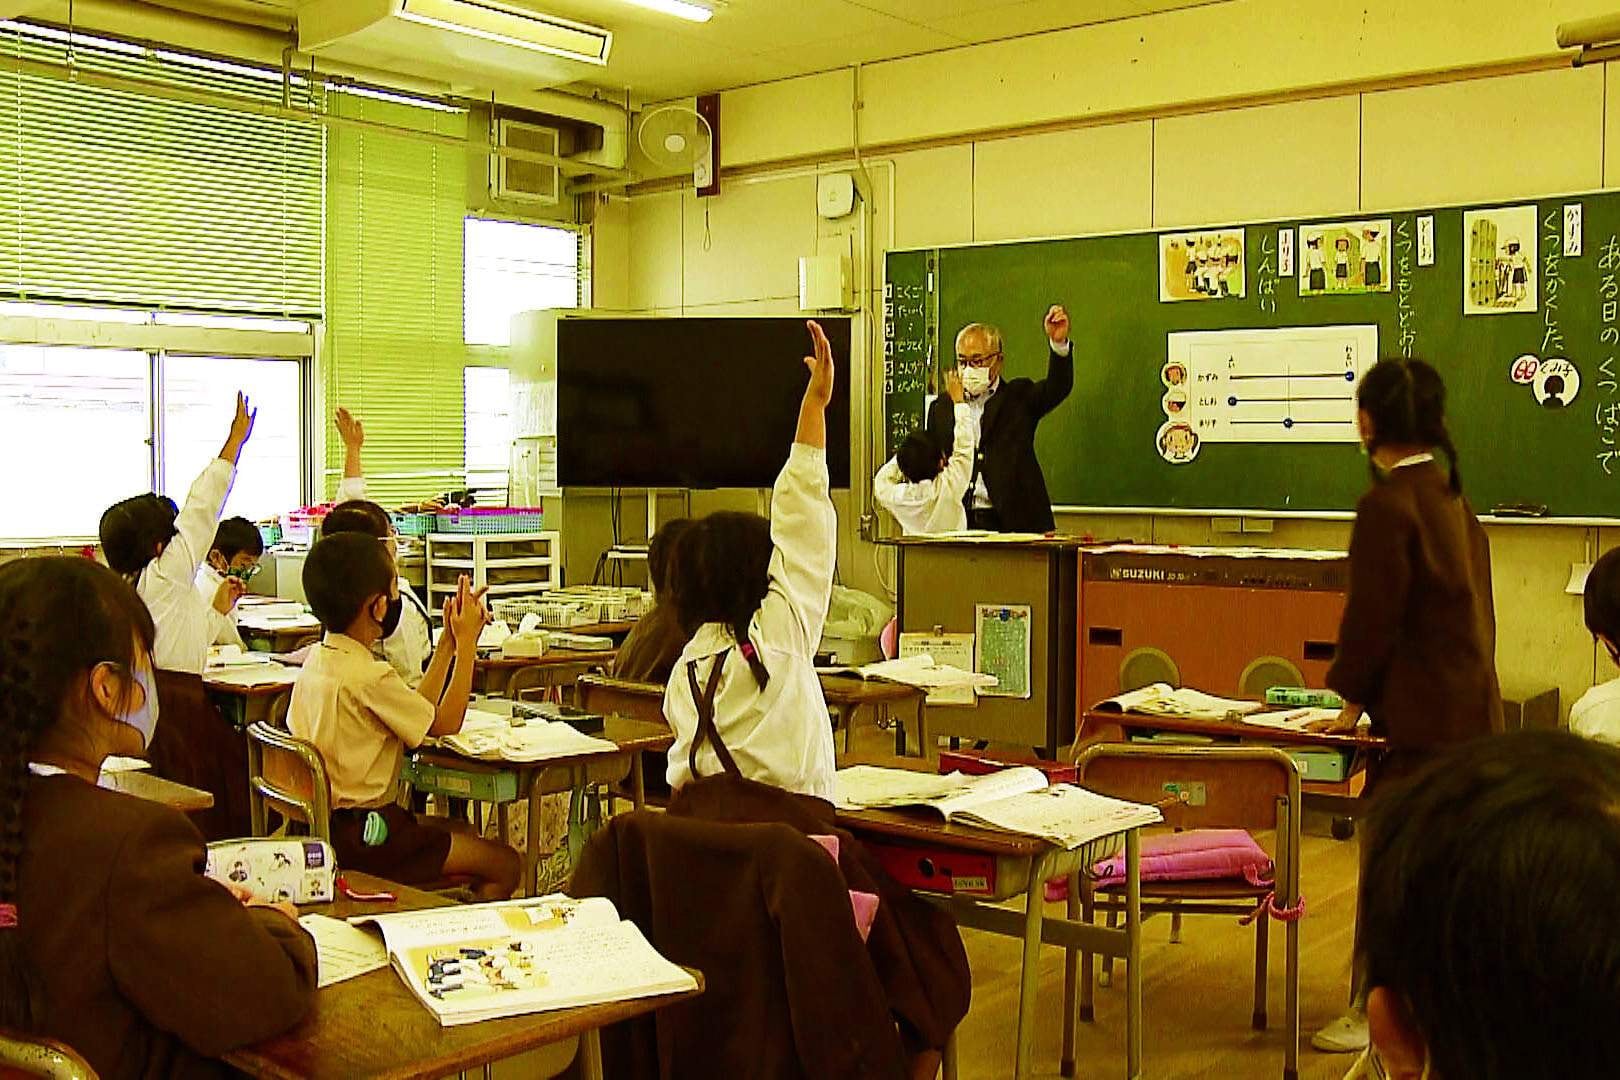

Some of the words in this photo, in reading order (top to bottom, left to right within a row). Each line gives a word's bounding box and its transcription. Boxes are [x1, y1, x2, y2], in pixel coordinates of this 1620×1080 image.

[1541, 209, 1565, 352] くつをかくした
[1122, 568, 1165, 580] SUZUKI
